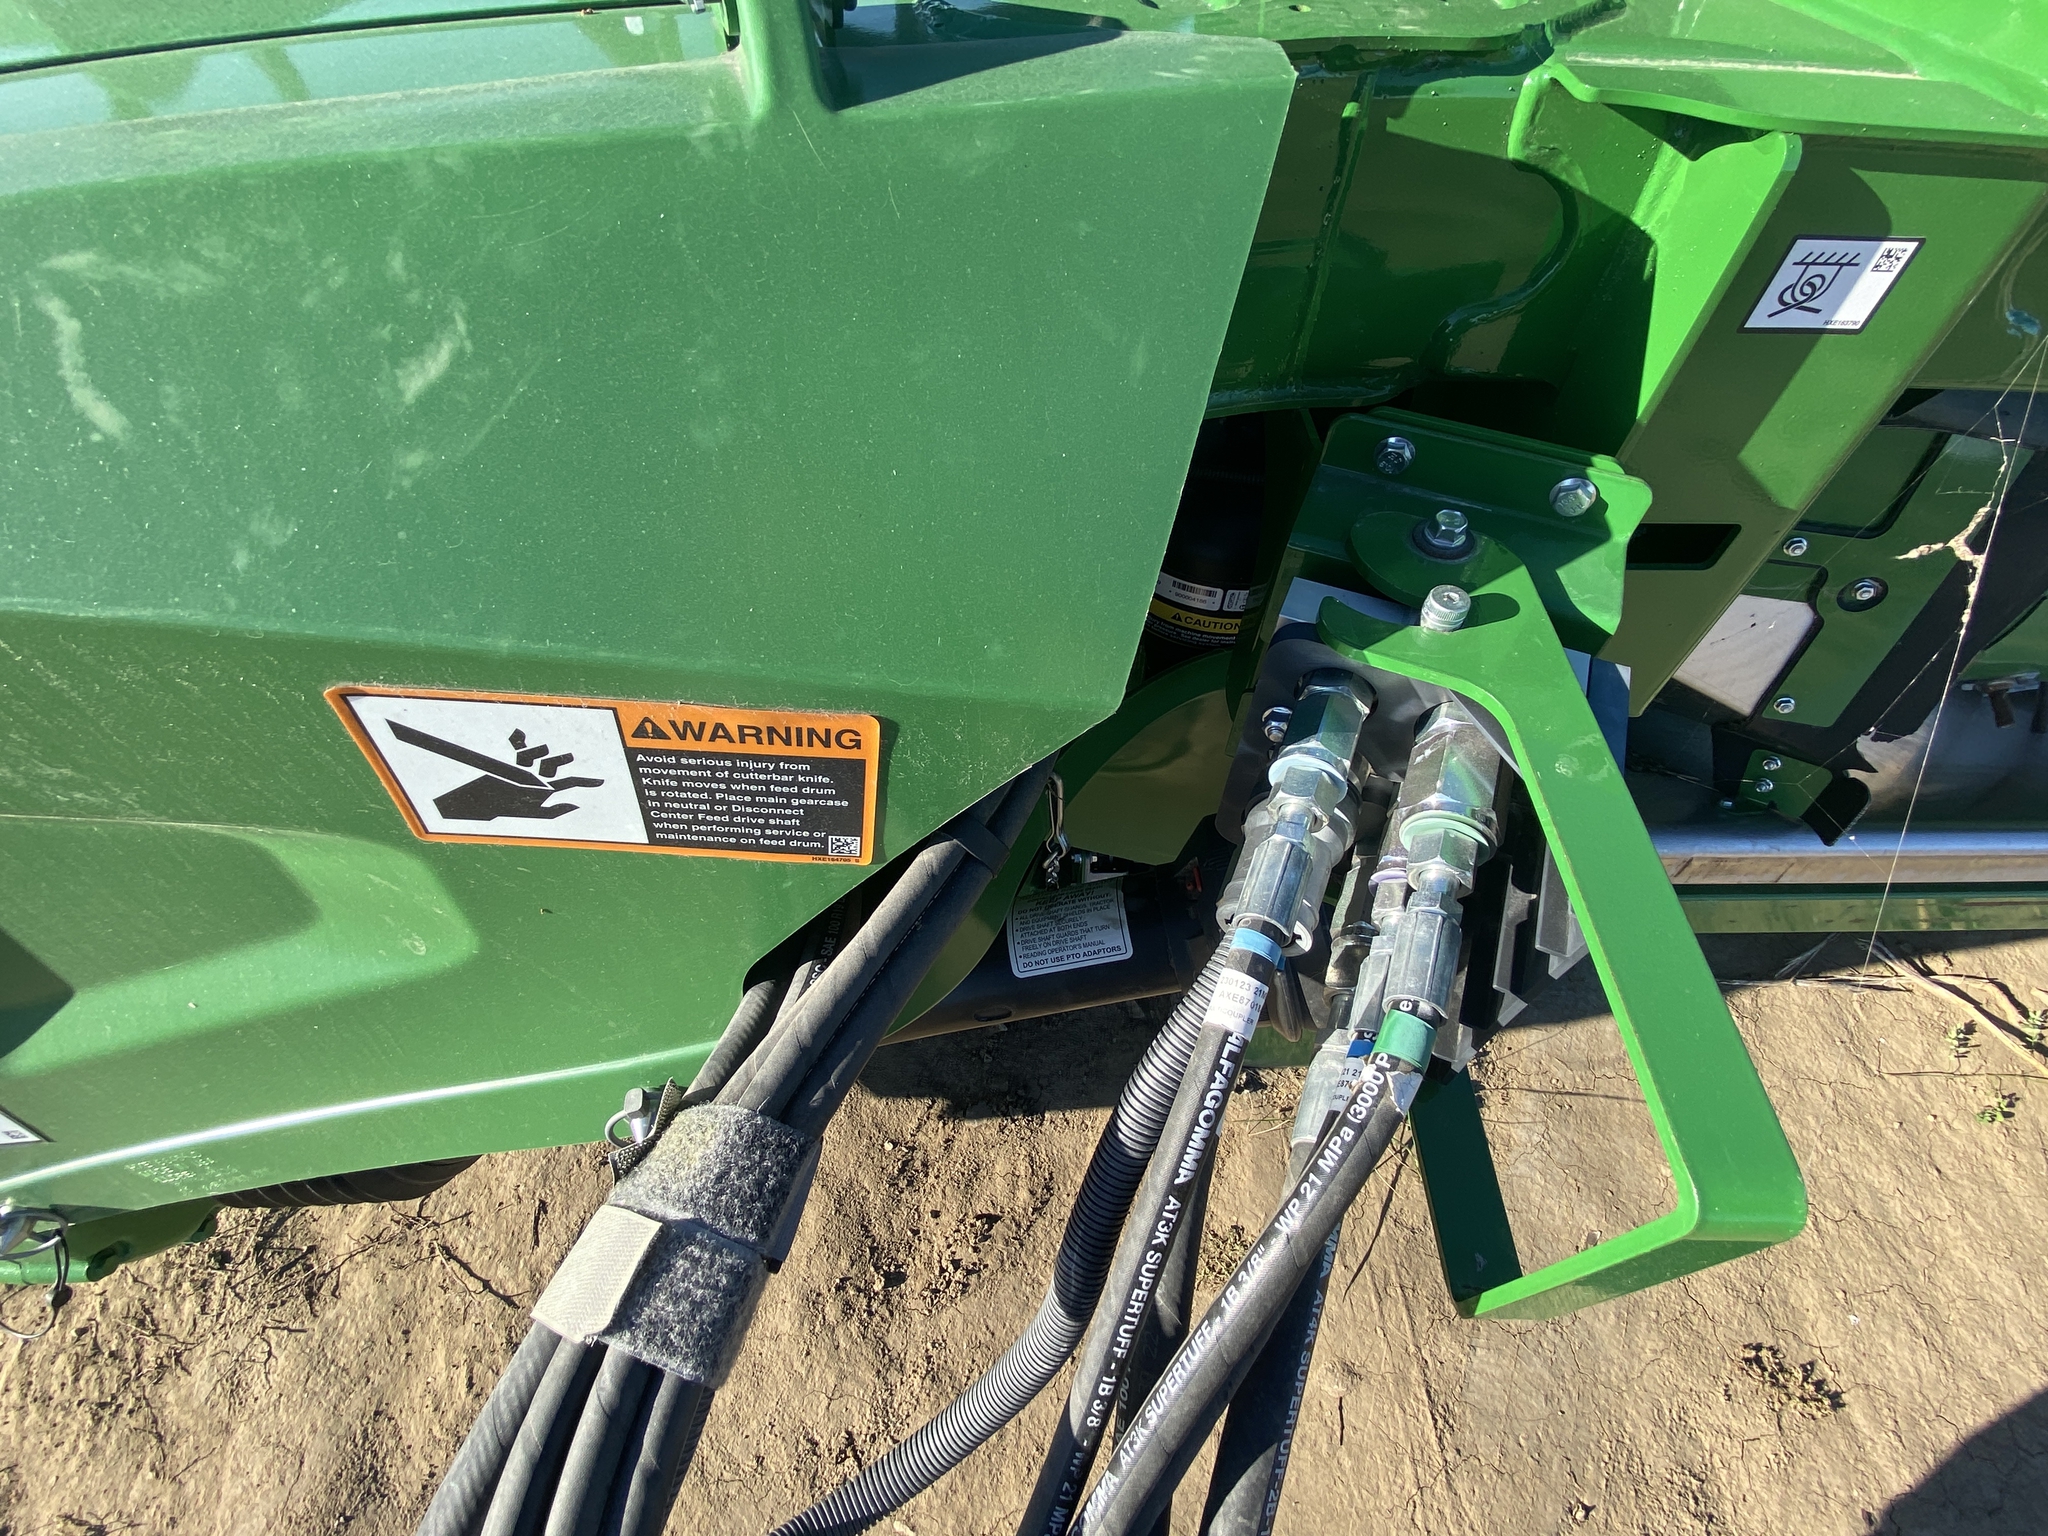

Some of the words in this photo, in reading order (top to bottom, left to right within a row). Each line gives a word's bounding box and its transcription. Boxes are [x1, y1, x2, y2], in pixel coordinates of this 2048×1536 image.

[668, 719, 862, 750] WARNING
[636, 753, 676, 764] Avoid
[680, 756, 732, 768] serious
[736, 759, 775, 771] injury
[779, 760, 811, 771] from
[639, 766, 712, 778] movement
[715, 769, 730, 779] of
[733, 770, 795, 782] cutterbar
[798, 774, 834, 784] knife.
[642, 777, 678, 788] Knife
[682, 780, 727, 790] moves
[730, 782, 766, 792] when
[769, 784, 798, 794] feed
[801, 786, 836, 795] drum
[648, 799, 661, 808] in
[664, 800, 710, 811] neutral
[714, 804, 728, 812] or
[732, 804, 804, 816] Disconnect
[661, 790, 712, 800] rotated.
[715, 792, 752, 802] Place
[755, 795, 787, 804] main
[791, 797, 849, 807] gearcase
[651, 810, 694, 820] Center
[698, 813, 729, 823] Feed
[733, 815, 766, 825] drive
[769, 817, 801, 827] shaft
[653, 821, 688, 831] when
[692, 824, 762, 836] performing
[765, 828, 809, 838] service
[812, 830, 827, 838] or
[656, 832, 737, 844] maintenance
[740, 836, 756, 845] on
[759, 837, 786, 847] feed
[789, 838, 825, 849] drum.
[1020, 925, 1035, 933] DRIVE
[1055, 916, 1083, 926] SECURELY
[1020, 929, 1048, 939] ATTACHED
[1021, 938, 1037, 946] DRIVE
[1038, 934, 1055, 943] SHAFT
[1056, 930, 1079, 939] GUARDS
[1022, 943, 1042, 952] FREELY
[1052, 938, 1069, 946] DRIVE
[1069, 935, 1087, 943] SHAFT
[1023, 950, 1046, 959] READING
[1083, 939, 1105, 948] MANUAL
[1051, 955, 1065, 963] USE
[1066, 952, 1080, 960] PTO
[1082, 944, 1121, 958] ADAPTORS
[1174, 1032, 1244, 1185] ALFAGOMMA
[1151, 1194, 1182, 1247] AT3K
[1120, 1418, 1150, 1470] AT3K
[1145, 1319, 1212, 1424] SUPERTUFF
[1221, 1284, 1241, 1311] 1B
[1274, 1197, 1301, 1233] WP
[1300, 1172, 1322, 1200] 21
[1317, 1126, 1355, 1174] MPa
[1347, 1072, 1385, 1123] (3000
[1112, 1250, 1163, 1359] SUPERTUFF
[1304, 1289, 1323, 1345] AT4K
[1098, 1375, 1117, 1396] 1B
